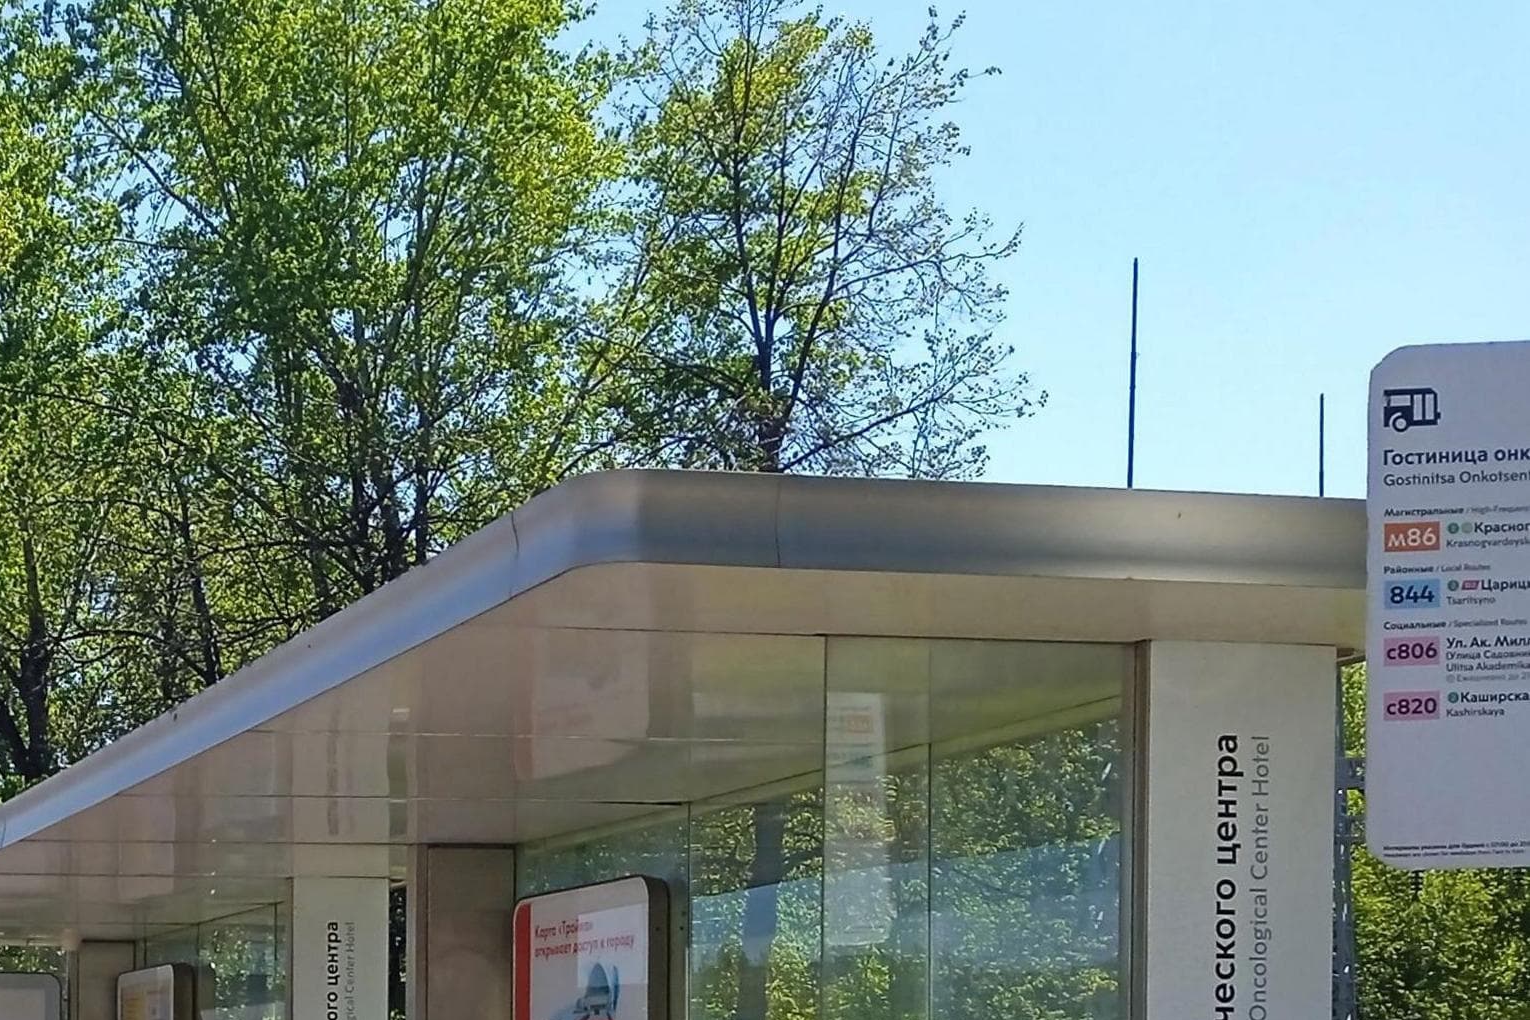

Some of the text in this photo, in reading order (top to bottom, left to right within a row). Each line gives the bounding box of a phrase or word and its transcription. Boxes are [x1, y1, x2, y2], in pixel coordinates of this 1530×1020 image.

[1383, 448, 1530, 466] Гостиница онк
[1384, 470, 1530, 486] Gostinitsa Onkotsen
[1384, 508, 1464, 517] Магистральные
[1384, 565, 1434, 574] Районные
[1390, 585, 1435, 604] 844
[1384, 621, 1446, 630] Социальные
[1446, 637, 1467, 648] Ул.
[1470, 636, 1491, 647] Ак.
[1446, 707, 1505, 717] Kashirskaya
[1251, 735, 1270, 797] Hotel
[1217, 734, 1244, 865] центра
[1250, 803, 1269, 881] Center
[345, 921, 356, 953] Hotel
[326, 921, 339, 986] центра
[345, 956, 355, 994] Center
